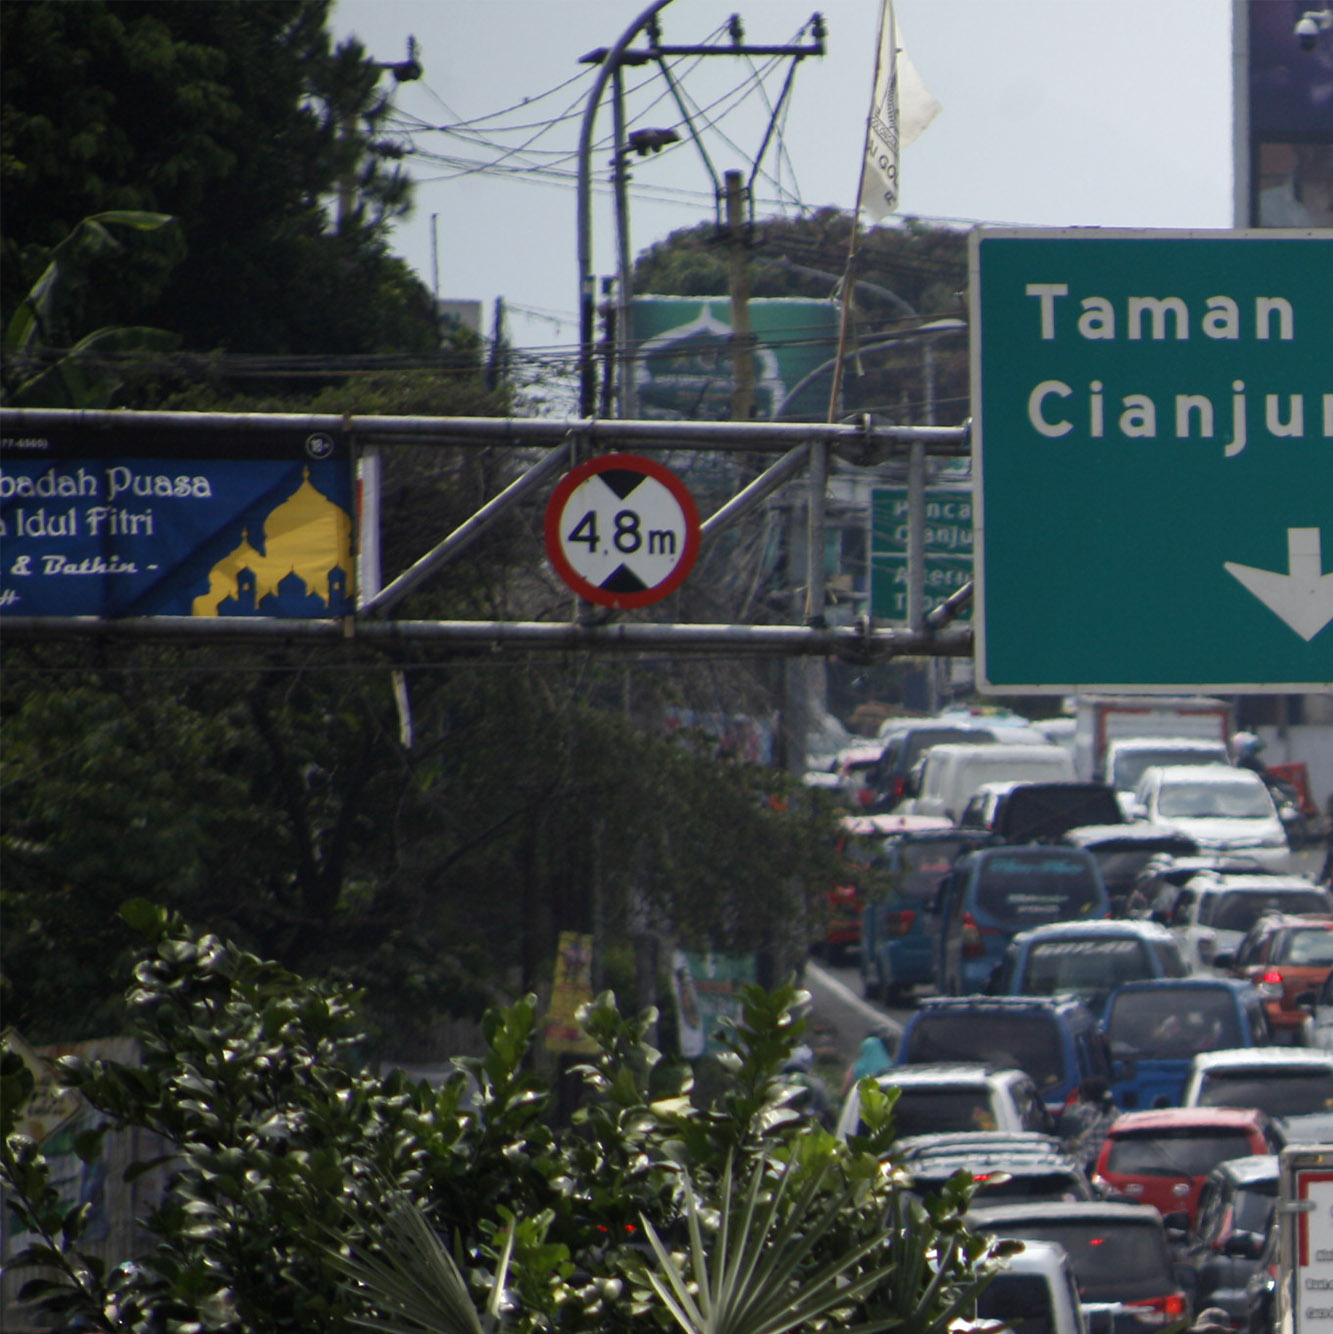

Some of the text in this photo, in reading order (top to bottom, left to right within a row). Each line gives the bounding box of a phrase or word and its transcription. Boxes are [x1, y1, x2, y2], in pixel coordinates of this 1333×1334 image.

[1026, 283, 1295, 341] Taman
[106, 466, 212, 499] Puasa
[16, 506, 154, 536] Idul Fitri
[11, 555, 31, 575] &
[42, 555, 138, 575] Bathin
